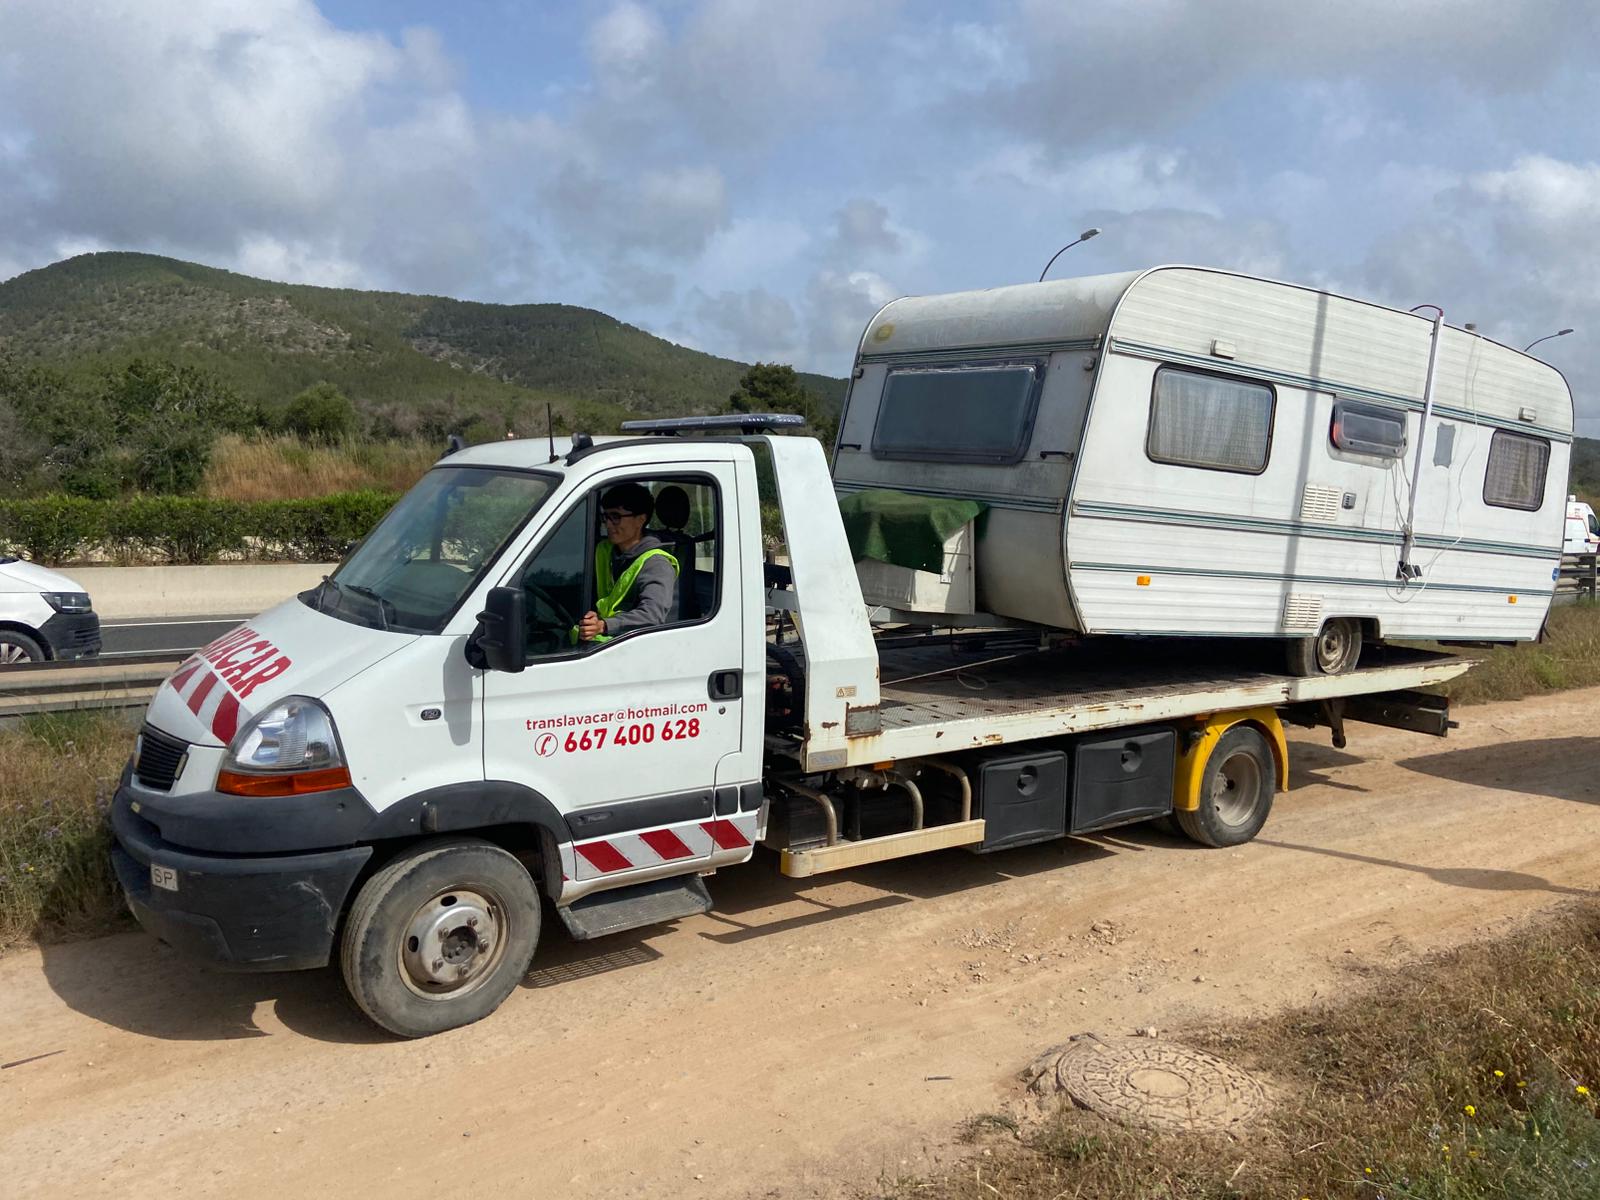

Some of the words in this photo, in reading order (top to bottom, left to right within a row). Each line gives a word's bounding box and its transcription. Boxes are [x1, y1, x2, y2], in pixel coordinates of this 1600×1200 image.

[526, 703, 707, 730] translavacar@hotmail.com
[564, 728, 608, 753] 667
[613, 723, 655, 747] 400
[661, 718, 701, 741] 628
[154, 868, 173, 884] SP
